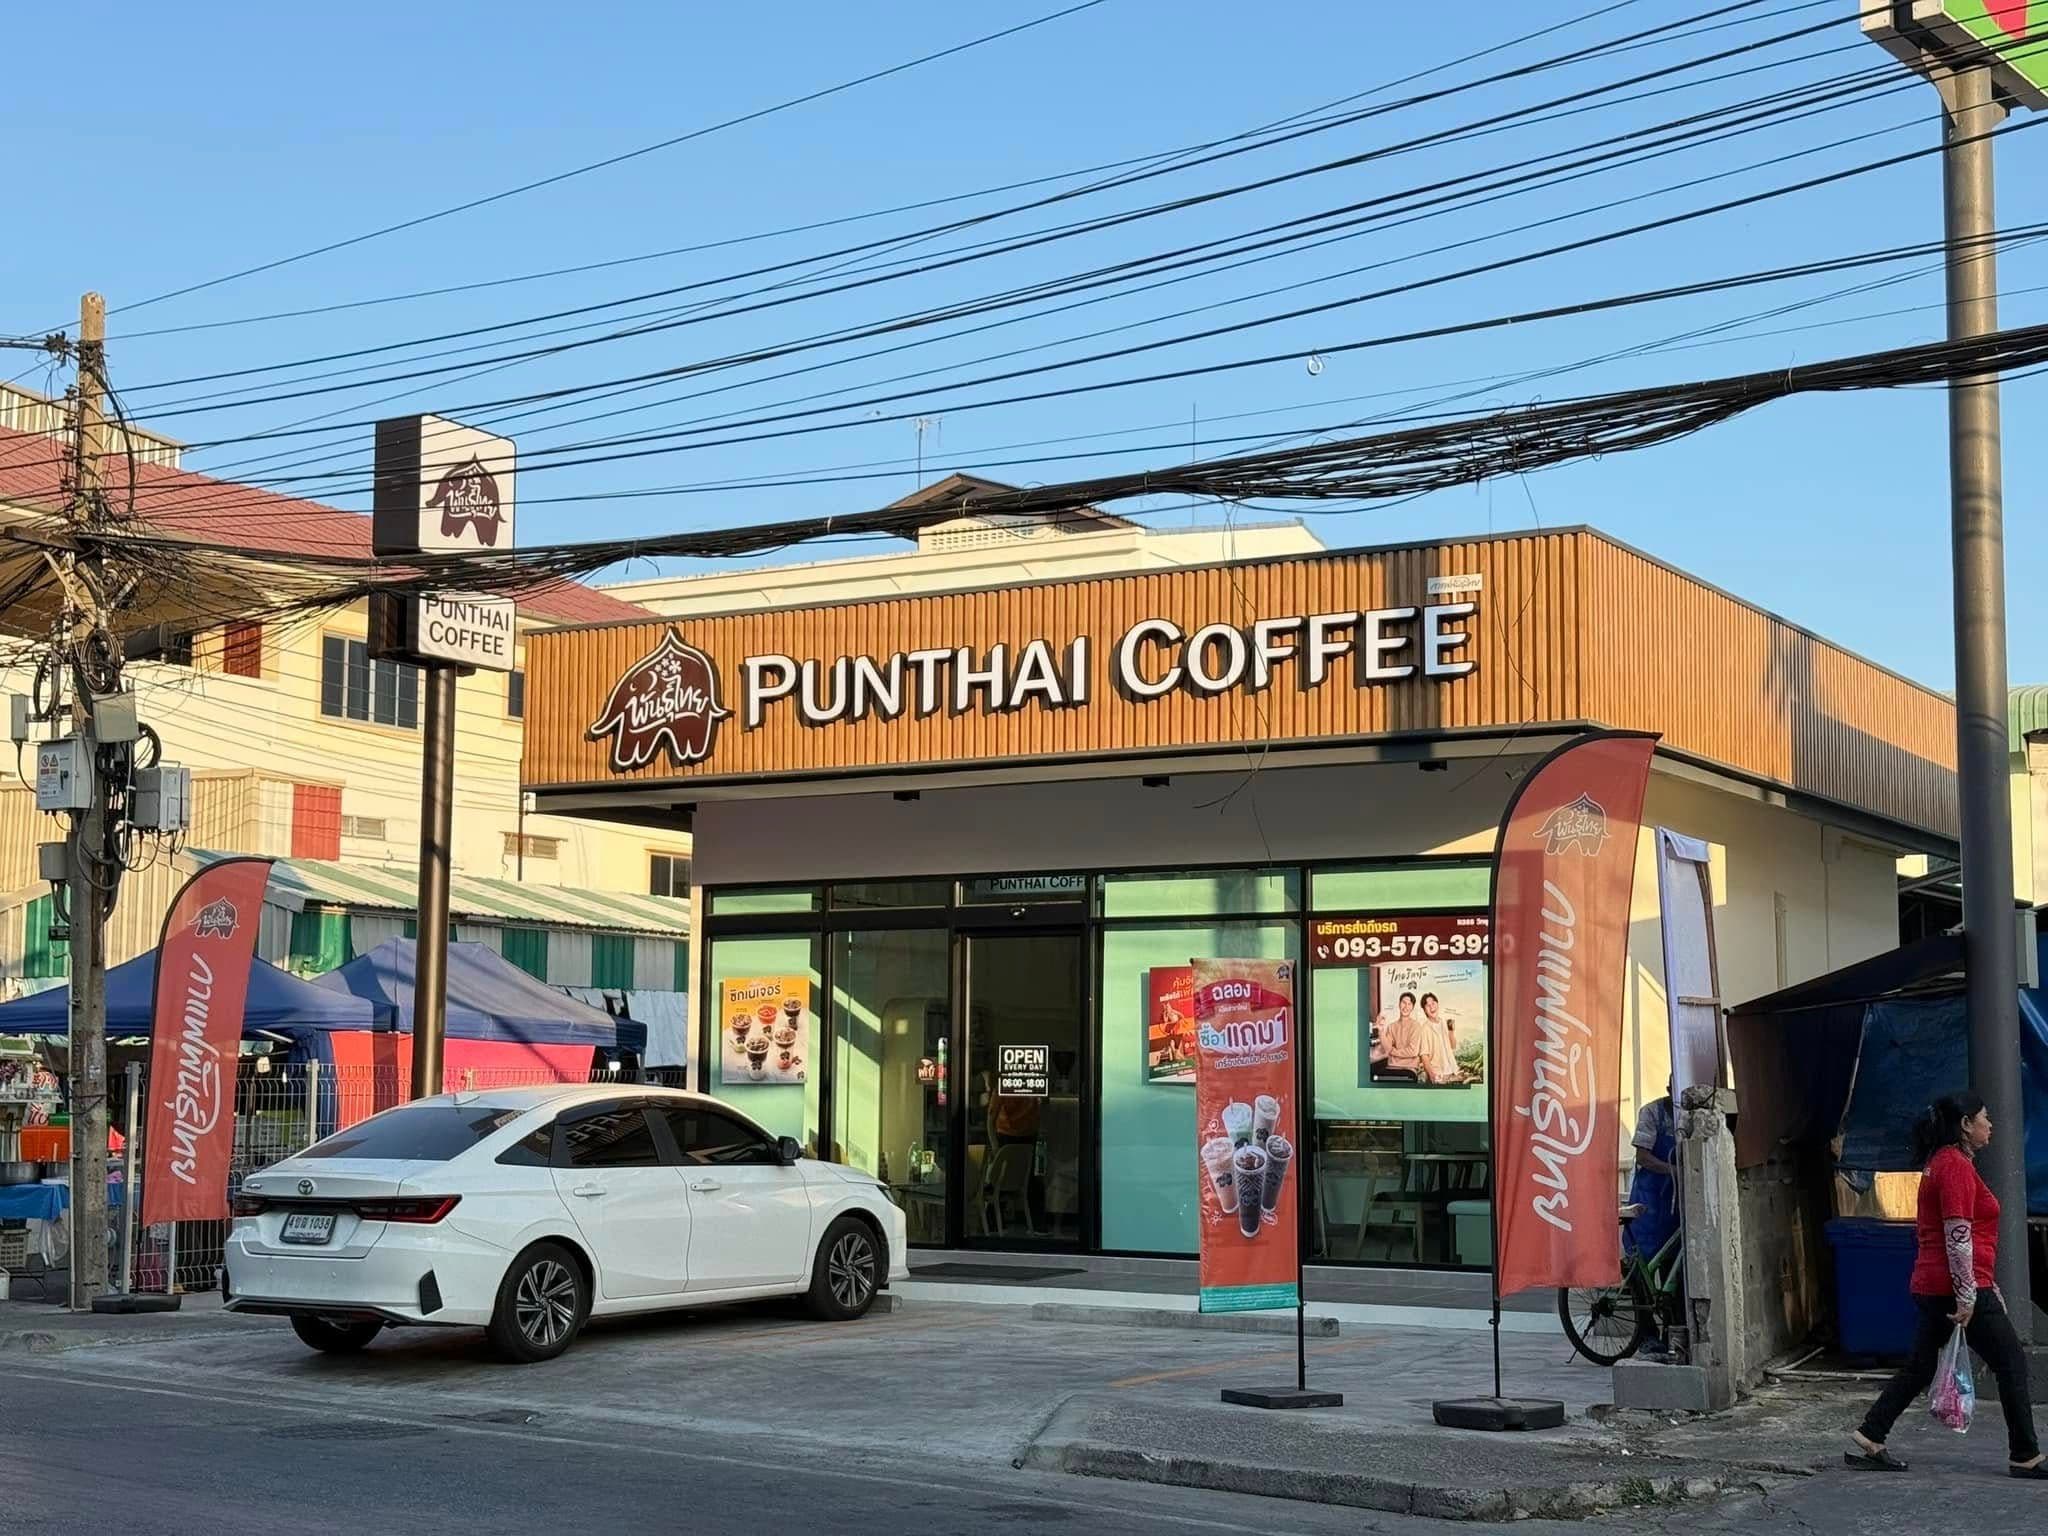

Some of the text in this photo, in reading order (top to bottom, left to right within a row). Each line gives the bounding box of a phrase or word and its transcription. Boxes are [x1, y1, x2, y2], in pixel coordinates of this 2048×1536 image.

[427, 597, 510, 632] PUNTHAI
[429, 620, 505, 656] COFFEE
[744, 602, 1475, 727] PUNTHAI COFFEE
[990, 877, 1046, 890] PUNTHAI
[1317, 919, 1398, 935] บริการส่งถึงรถ
[730, 977, 781, 1002] ซิกเนเจอร์
[1212, 983, 1251, 1001] ฉลอง
[1004, 1049, 1044, 1064] OPEN
